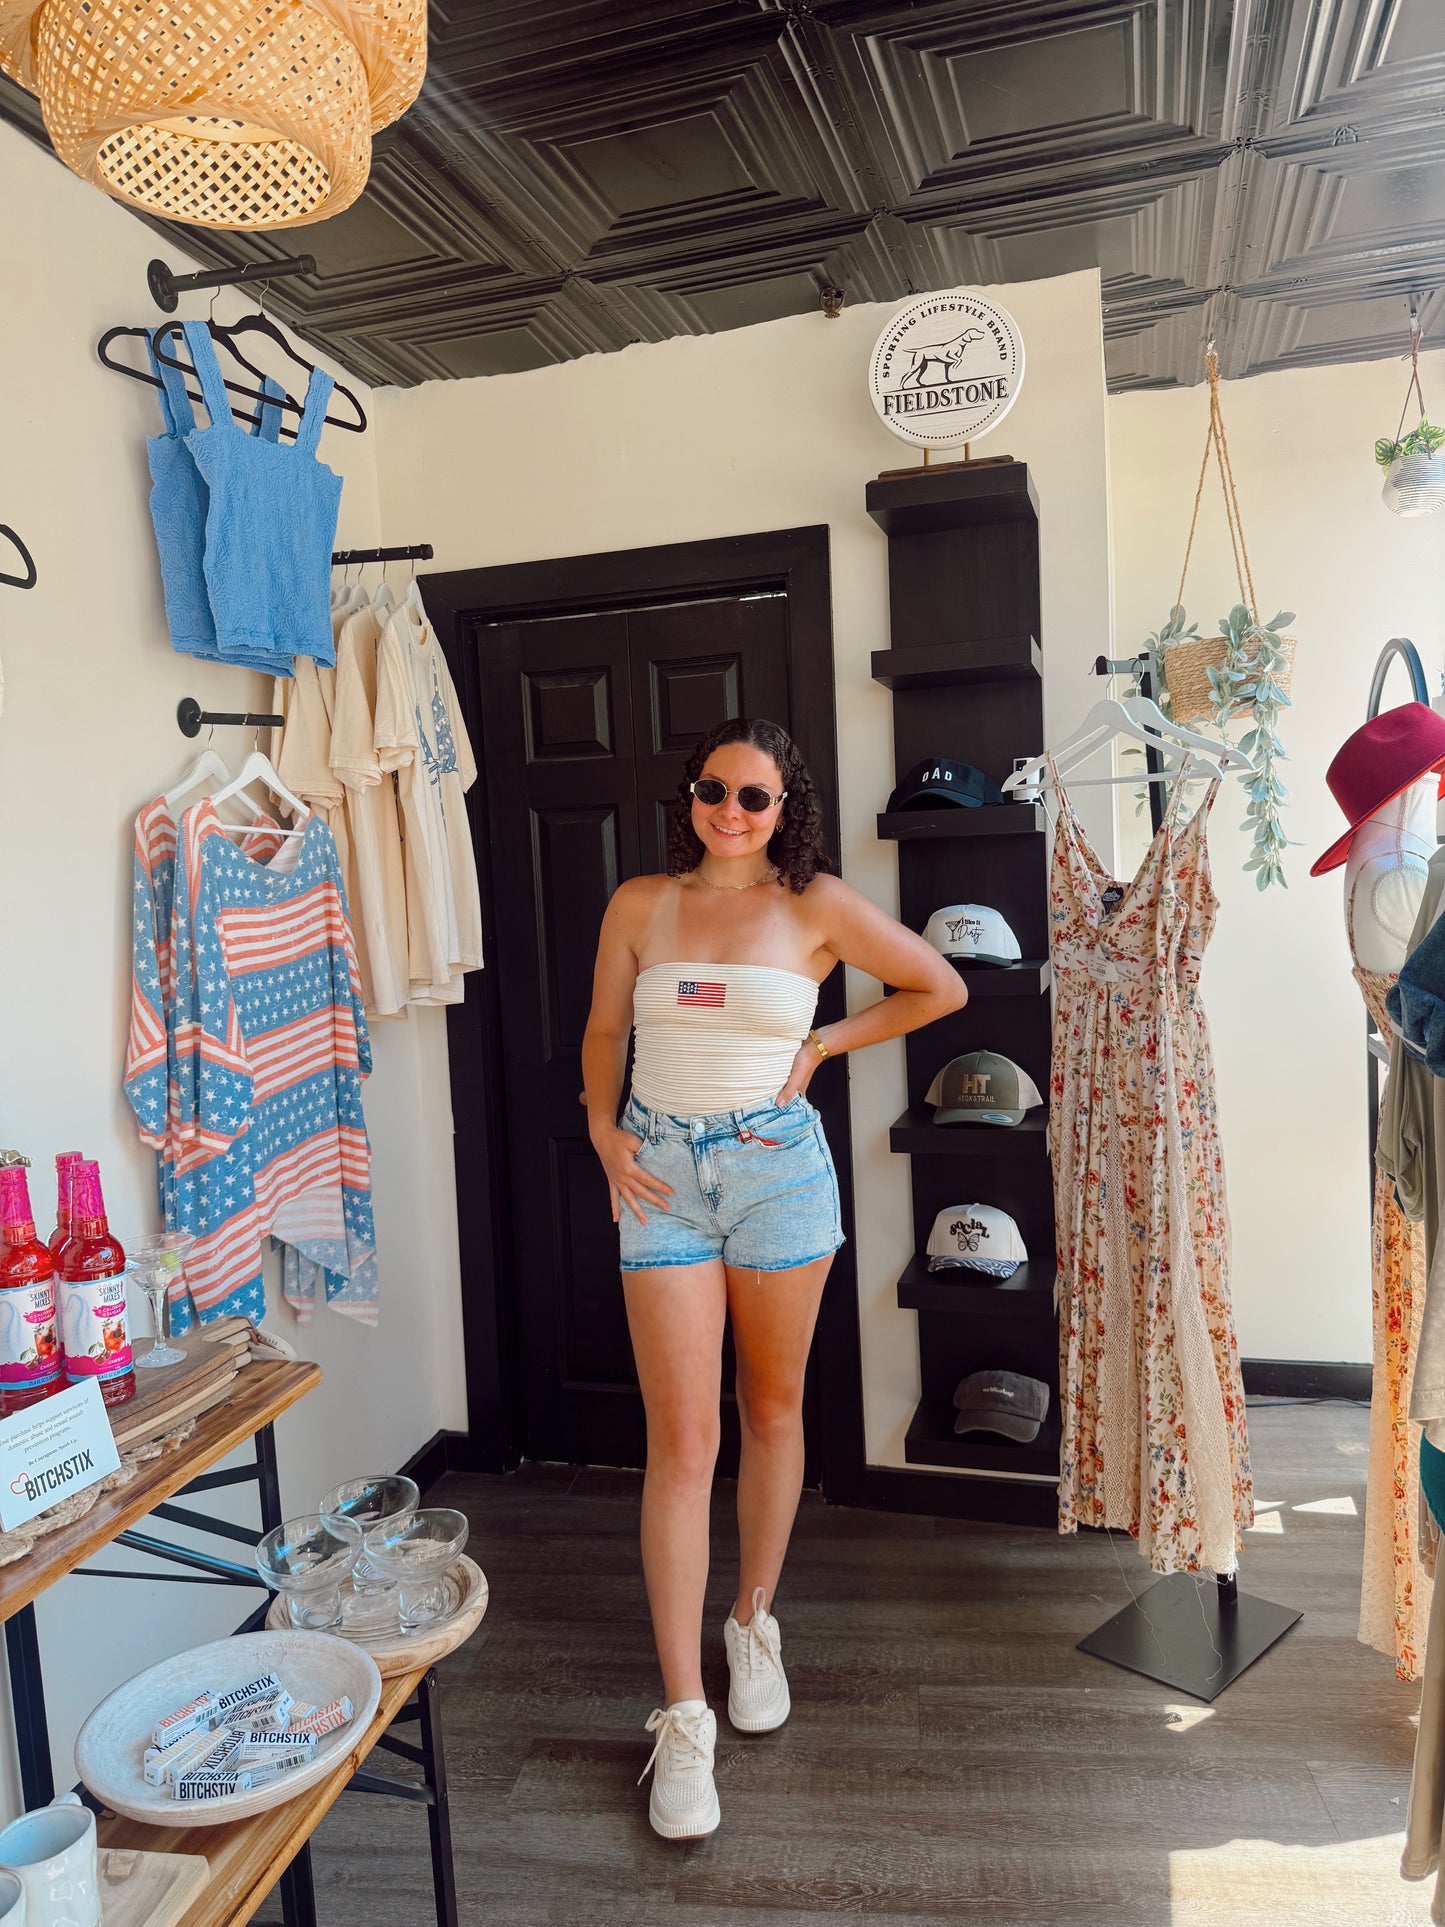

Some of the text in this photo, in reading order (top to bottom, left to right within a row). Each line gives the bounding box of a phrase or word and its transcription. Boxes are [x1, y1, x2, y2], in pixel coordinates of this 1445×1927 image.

[882, 303, 1008, 378] SPORTING LIFESTYLE BRAND
[882, 377, 1009, 416] FIELDSTONE
[922, 767, 953, 782] DAD
[957, 924, 985, 945] Dirty
[962, 1074, 991, 1094] HT
[30, 1289, 50, 1302] SKINNY
[98, 1284, 120, 1297] SKINNY
[103, 1291, 121, 1303] MIXES
[34, 1297, 51, 1309] MIXES
[10, 1427, 32, 1442] purchase
[31, 1421, 45, 1431] helps
[45, 1411, 63, 1423] support
[63, 1401, 84, 1415] survivors
[8, 1437, 30, 1451] domestic
[30, 1430, 44, 1441] abuse
[44, 1425, 54, 1433] and
[53, 1416, 69, 1428] sexual
[24, 1436, 49, 1454] prevention
[25, 1448, 95, 1502] BITCHSTIX
[218, 1674, 275, 1710] BITCHSTIX
[250, 1732, 311, 1744] BITCHSTIX
[201, 1730, 246, 1770] BITCHSTIX
[180, 1771, 242, 1781] BITCHSTIX
[179, 1782, 237, 1800] BITCHSTIX
